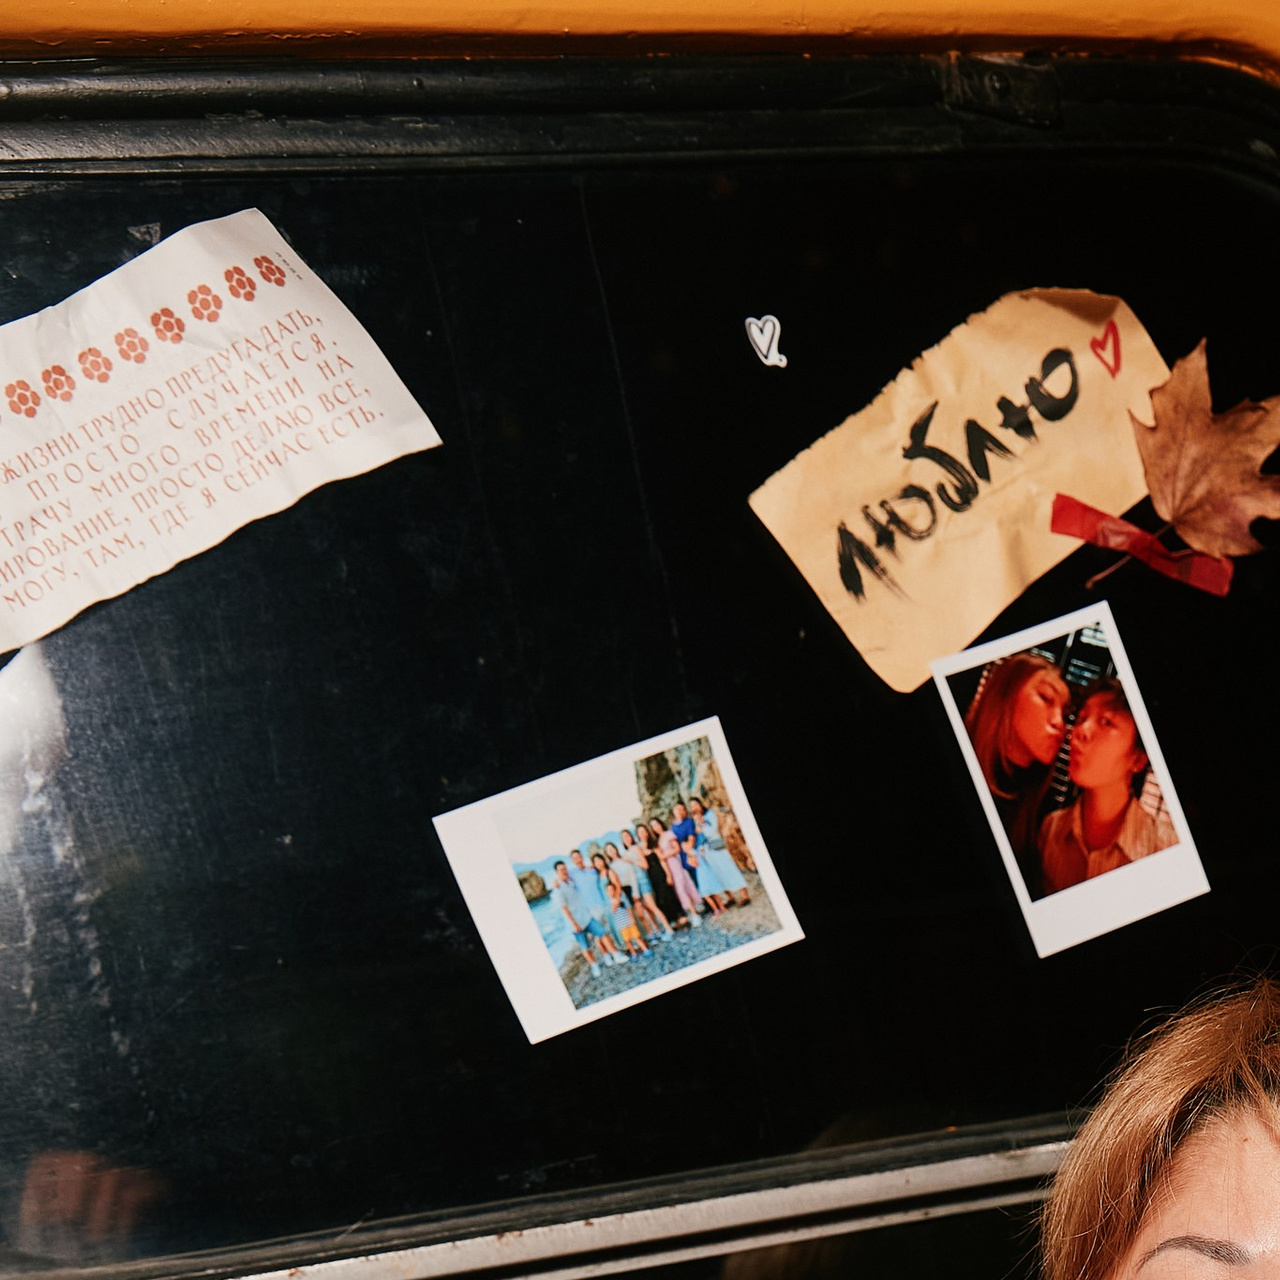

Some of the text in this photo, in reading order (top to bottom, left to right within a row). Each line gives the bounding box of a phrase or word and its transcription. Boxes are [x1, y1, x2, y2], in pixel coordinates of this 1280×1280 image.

[0, 309, 323, 484] ЖИЗНИ ТРУДНО ПРЕДУГАДАТЬ,
[0, 354, 354, 548] ТРАЧУ МНОГО ВРЕМЕНИ НА
[0, 378, 371, 583] ИРОВАНИЕ, ПРОСТО ДЕЛАЮ ВСЕ,
[27, 332, 338, 501] ПРОСТО СЛУЧАЕТСЯ.
[3, 562, 80, 612] МОГУ,
[83, 533, 146, 568] ТАМ,
[149, 501, 193, 536] ГДЕ
[201, 487, 217, 509] Я
[318, 405, 385, 445] ЕСТЬ.
